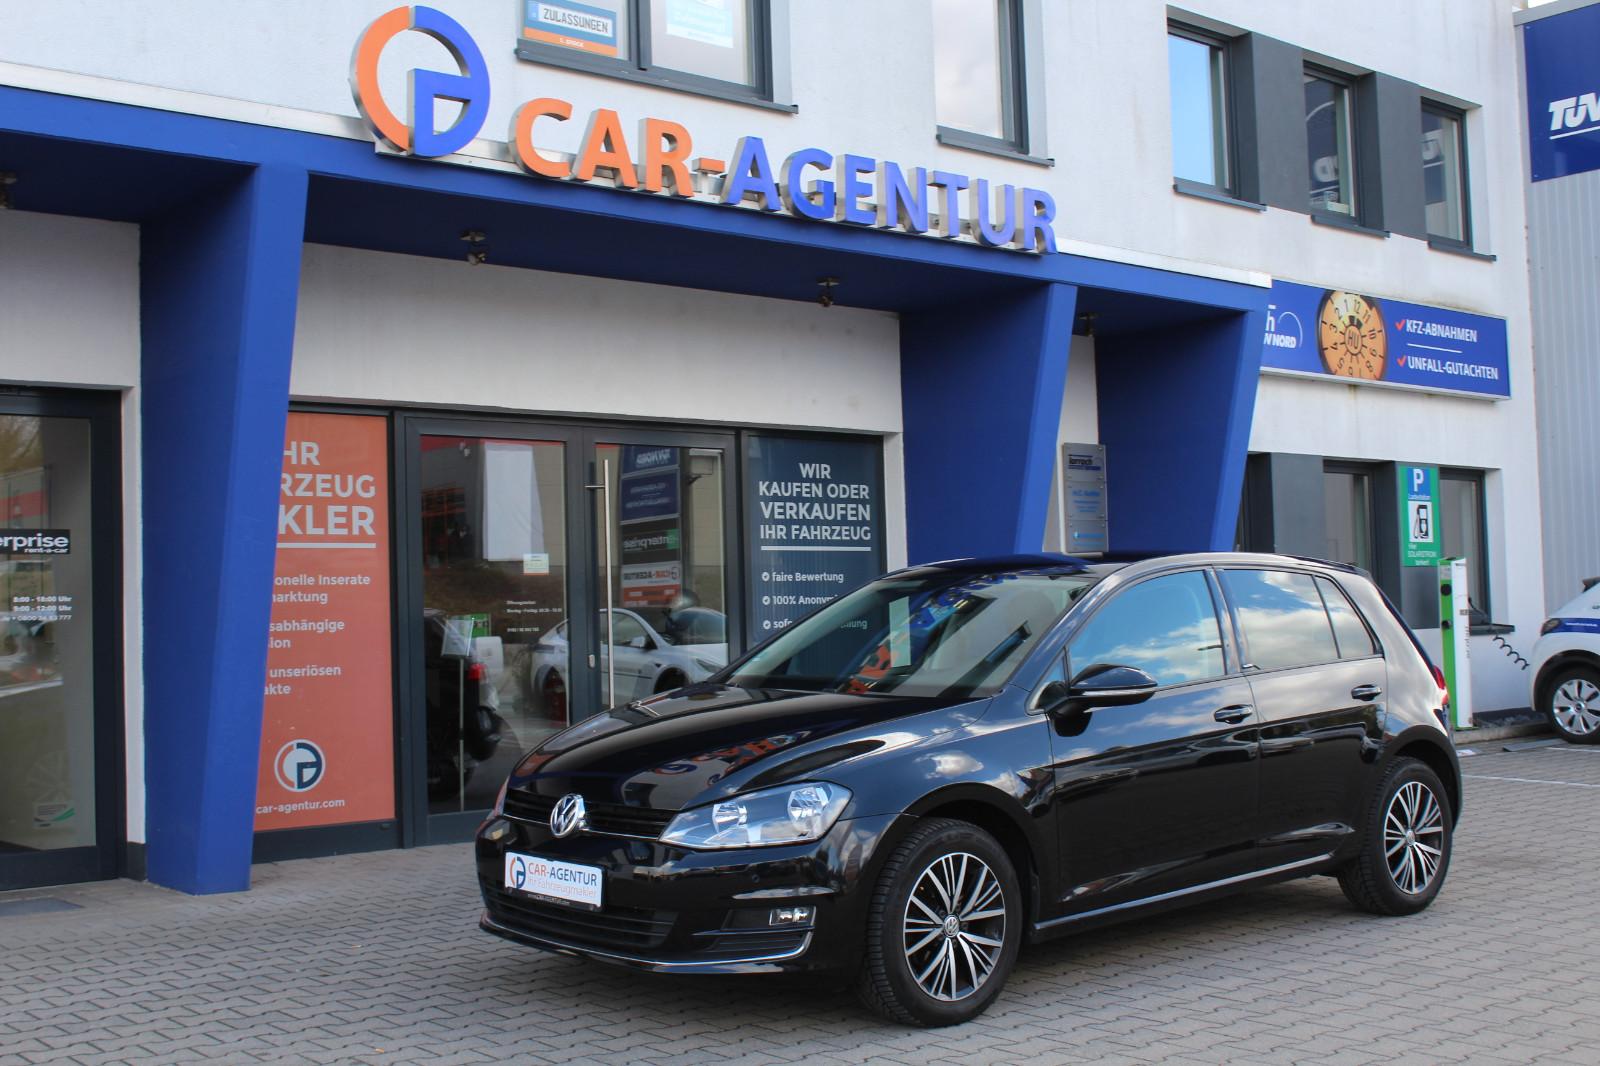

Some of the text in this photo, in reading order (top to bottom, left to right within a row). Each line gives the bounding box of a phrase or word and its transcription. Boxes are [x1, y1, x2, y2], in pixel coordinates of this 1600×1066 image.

[543, 8, 608, 33] ZULASSUNGEN
[508, 97, 1058, 255] CAR-AGENTUR
[1406, 319, 1478, 343] KFZ-ABNAHMEN
[1408, 355, 1499, 380] UNFALL-GUTACHTEN
[284, 440, 321, 466] HR
[799, 462, 832, 480] WIR
[1413, 467, 1425, 493] P
[280, 473, 376, 499] RZEUG
[758, 480, 870, 500] KAUFEN ODER
[278, 504, 376, 536] KLER
[760, 501, 871, 521] VERKAUFEN
[760, 524, 872, 541] IHR FAHRZEUG
[275, 574, 371, 586] onelle Inserate
[772, 572, 844, 583] faire Bewertung
[272, 591, 329, 605] arktung
[773, 595, 796, 605] 100%
[270, 619, 345, 633] sabhängige
[269, 636, 291, 648] ion
[269, 665, 342, 678] unseriösen
[528, 862, 598, 887] CAR-AGENTUR
